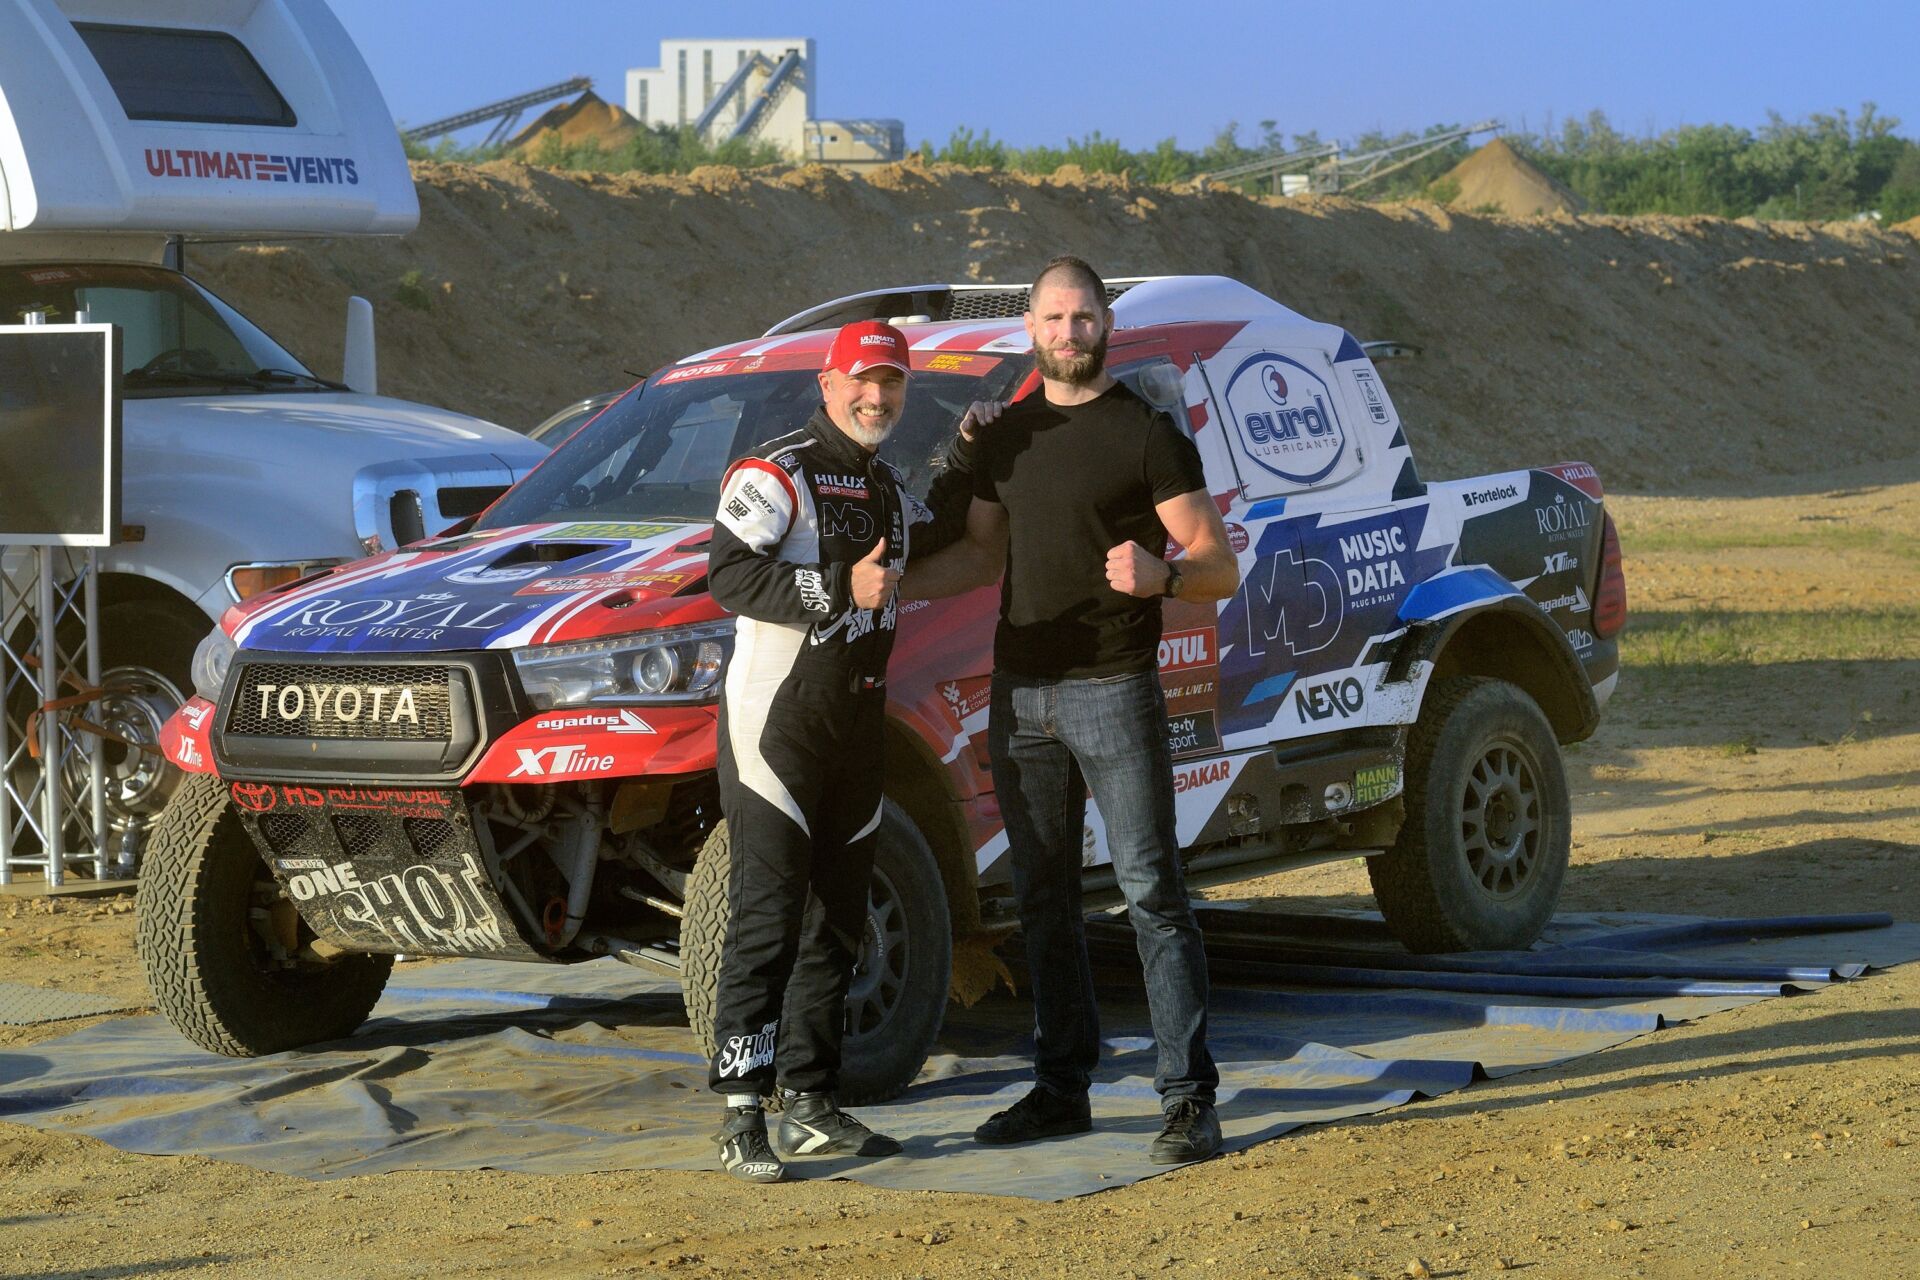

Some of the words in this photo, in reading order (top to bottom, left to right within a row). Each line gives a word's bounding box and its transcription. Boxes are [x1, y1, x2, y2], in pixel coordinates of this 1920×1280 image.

[664, 363, 728, 381] MOTUL
[1245, 394, 1334, 444] eurol
[1254, 438, 1338, 457] LUBRICANTS
[815, 474, 866, 488] HILUX
[1562, 466, 1597, 480] HILUX
[745, 481, 776, 514] ULTIMATE
[1471, 484, 1518, 505] Fortelock
[728, 499, 748, 517] OMP
[1535, 501, 1590, 534] ROYAL
[1339, 526, 1406, 563] MUSIC
[1346, 560, 1406, 596] DATA
[1351, 598, 1370, 609] PLUG
[1371, 597, 1376, 605] &
[1378, 593, 1395, 603] PLAY
[1538, 594, 1577, 613] agados
[270, 599, 517, 630] ROYAL
[284, 626, 358, 637] ROYAL
[367, 626, 445, 641] WATER
[1157, 634, 1207, 668] OTUL
[1185, 683, 1204, 696] LIVE
[1295, 676, 1363, 724] NEXO
[257, 684, 418, 724] TOYOTA
[537, 715, 619, 730] agados
[1169, 732, 1198, 754] sport
[507, 744, 615, 778] XTline
[1178, 761, 1230, 793] DAKAR
[1356, 766, 1396, 787] MANN
[283, 784, 325, 807] HS
[1357, 783, 1393, 802] FILTE
[290, 861, 362, 901] ONE
[719, 1031, 775, 1078] SHOT
[737, 1050, 774, 1078] energy
[743, 1163, 779, 1174] OMP
